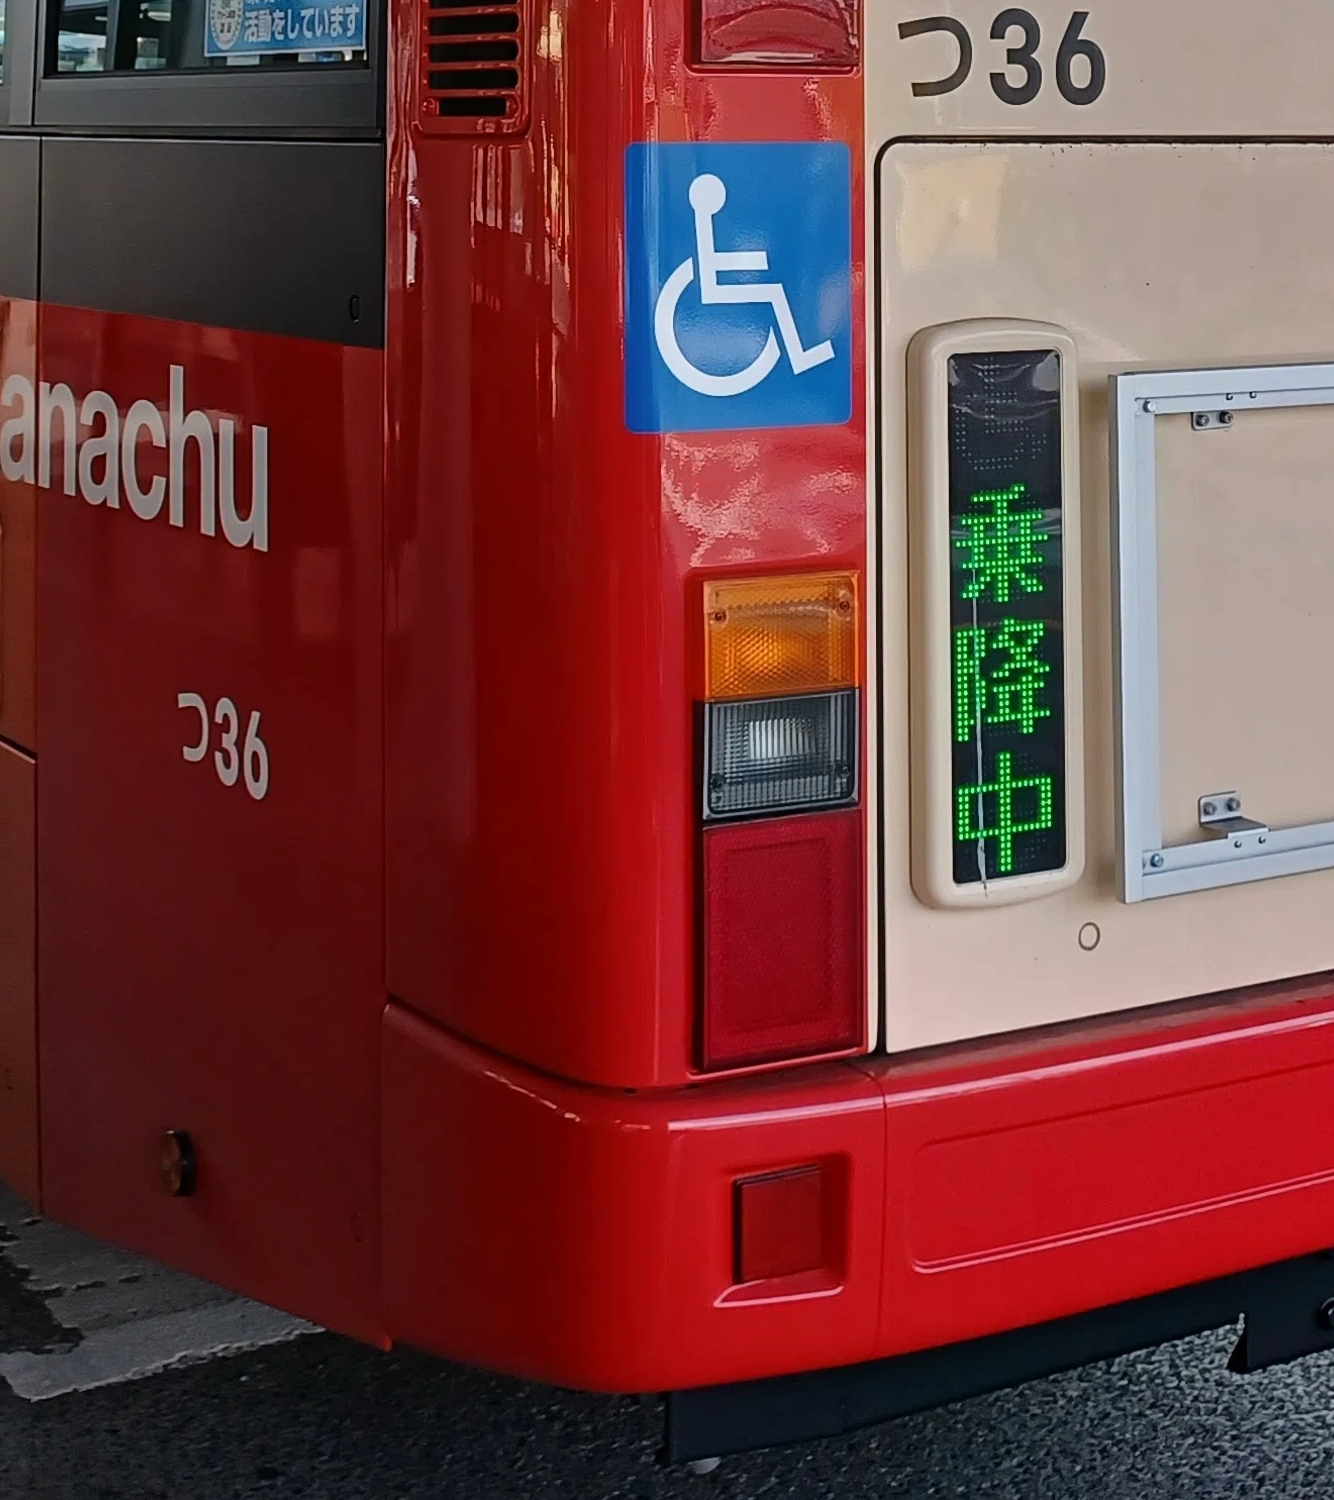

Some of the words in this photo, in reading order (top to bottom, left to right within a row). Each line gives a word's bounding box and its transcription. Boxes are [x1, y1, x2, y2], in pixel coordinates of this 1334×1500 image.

[244, 4, 360, 43] 活動をしています
[898, 7, 1106, 105] つ36
[954, 484, 1052, 873] 乗降中
[177, 691, 270, 801] つ36
